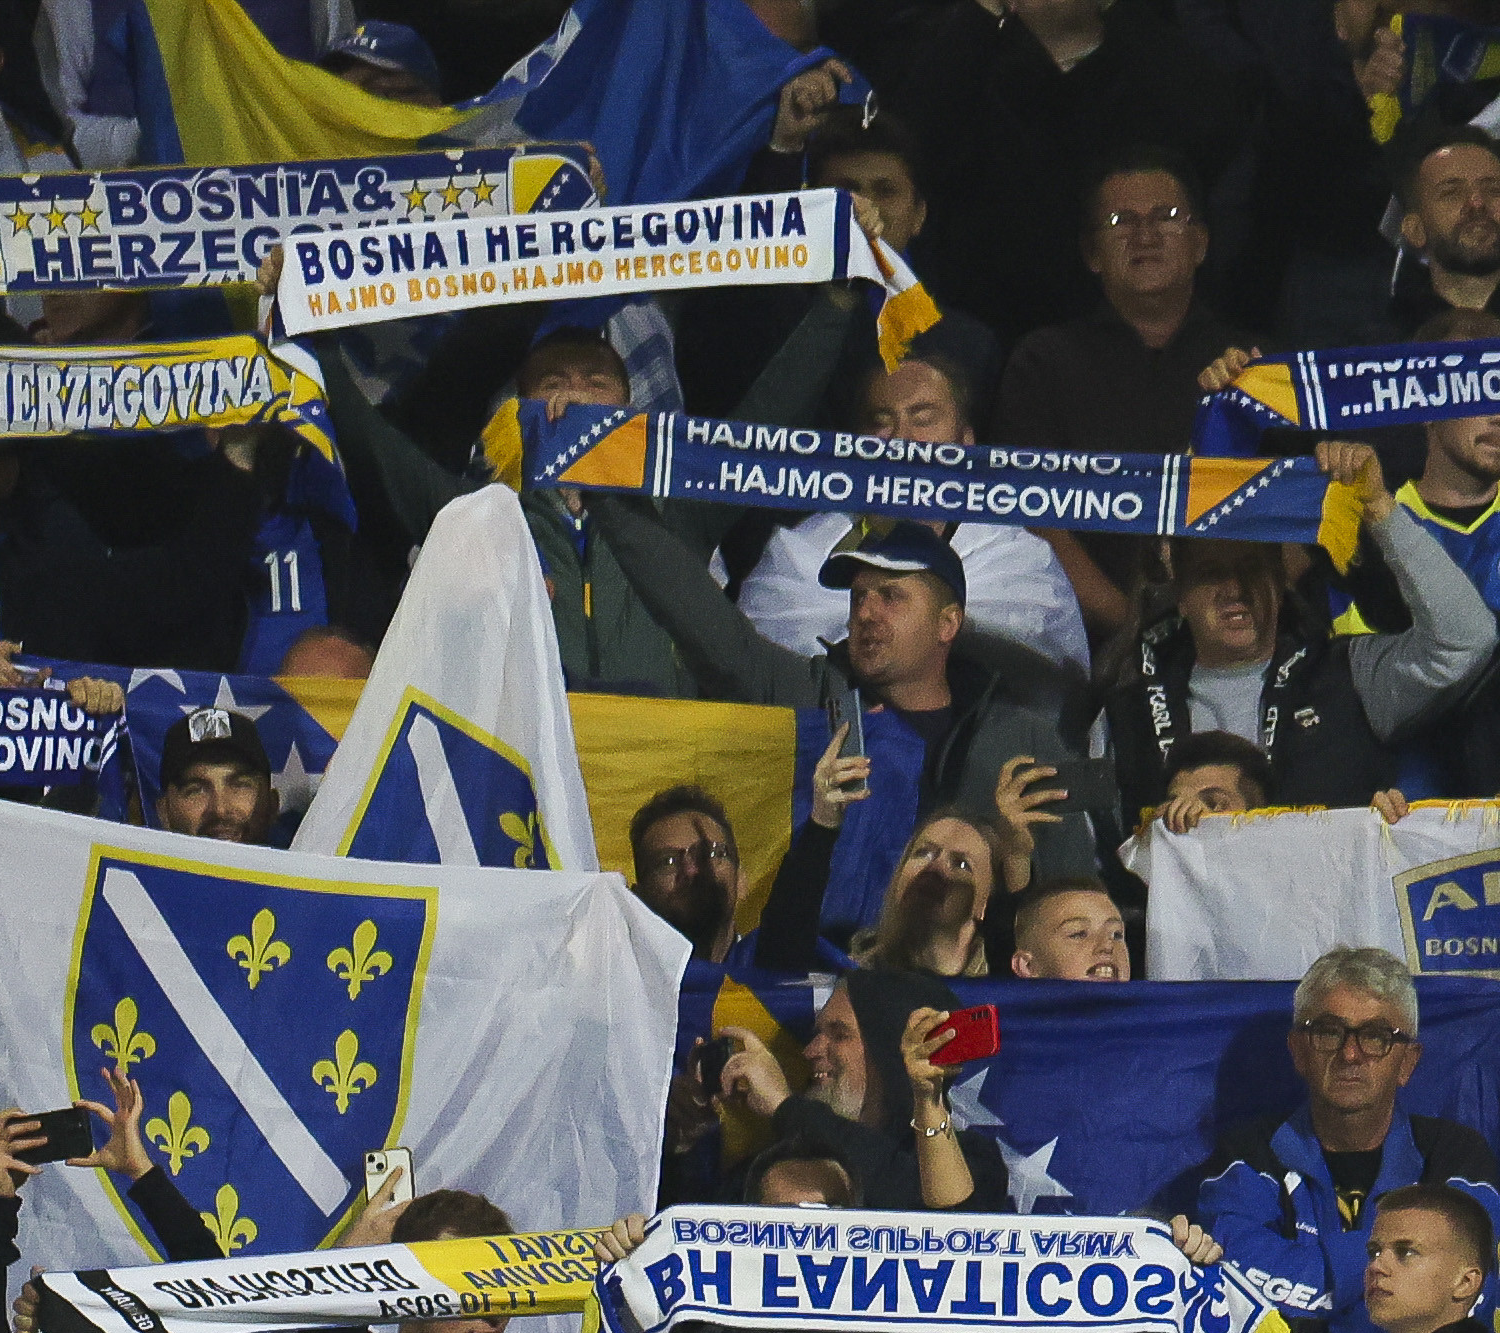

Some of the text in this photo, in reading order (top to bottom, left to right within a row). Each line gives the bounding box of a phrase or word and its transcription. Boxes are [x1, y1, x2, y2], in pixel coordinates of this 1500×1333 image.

[291, 197, 806, 285] BOSNA I HERCEGOVINA
[308, 283, 395, 316] HAJMO
[616, 245, 808, 279] HERCEGOVINO
[688, 420, 820, 453] HAJMO
[834, 433, 972, 469] BOSNO,
[867, 476, 1142, 520] HERCEGOVINO
[265, 551, 301, 611] 11
